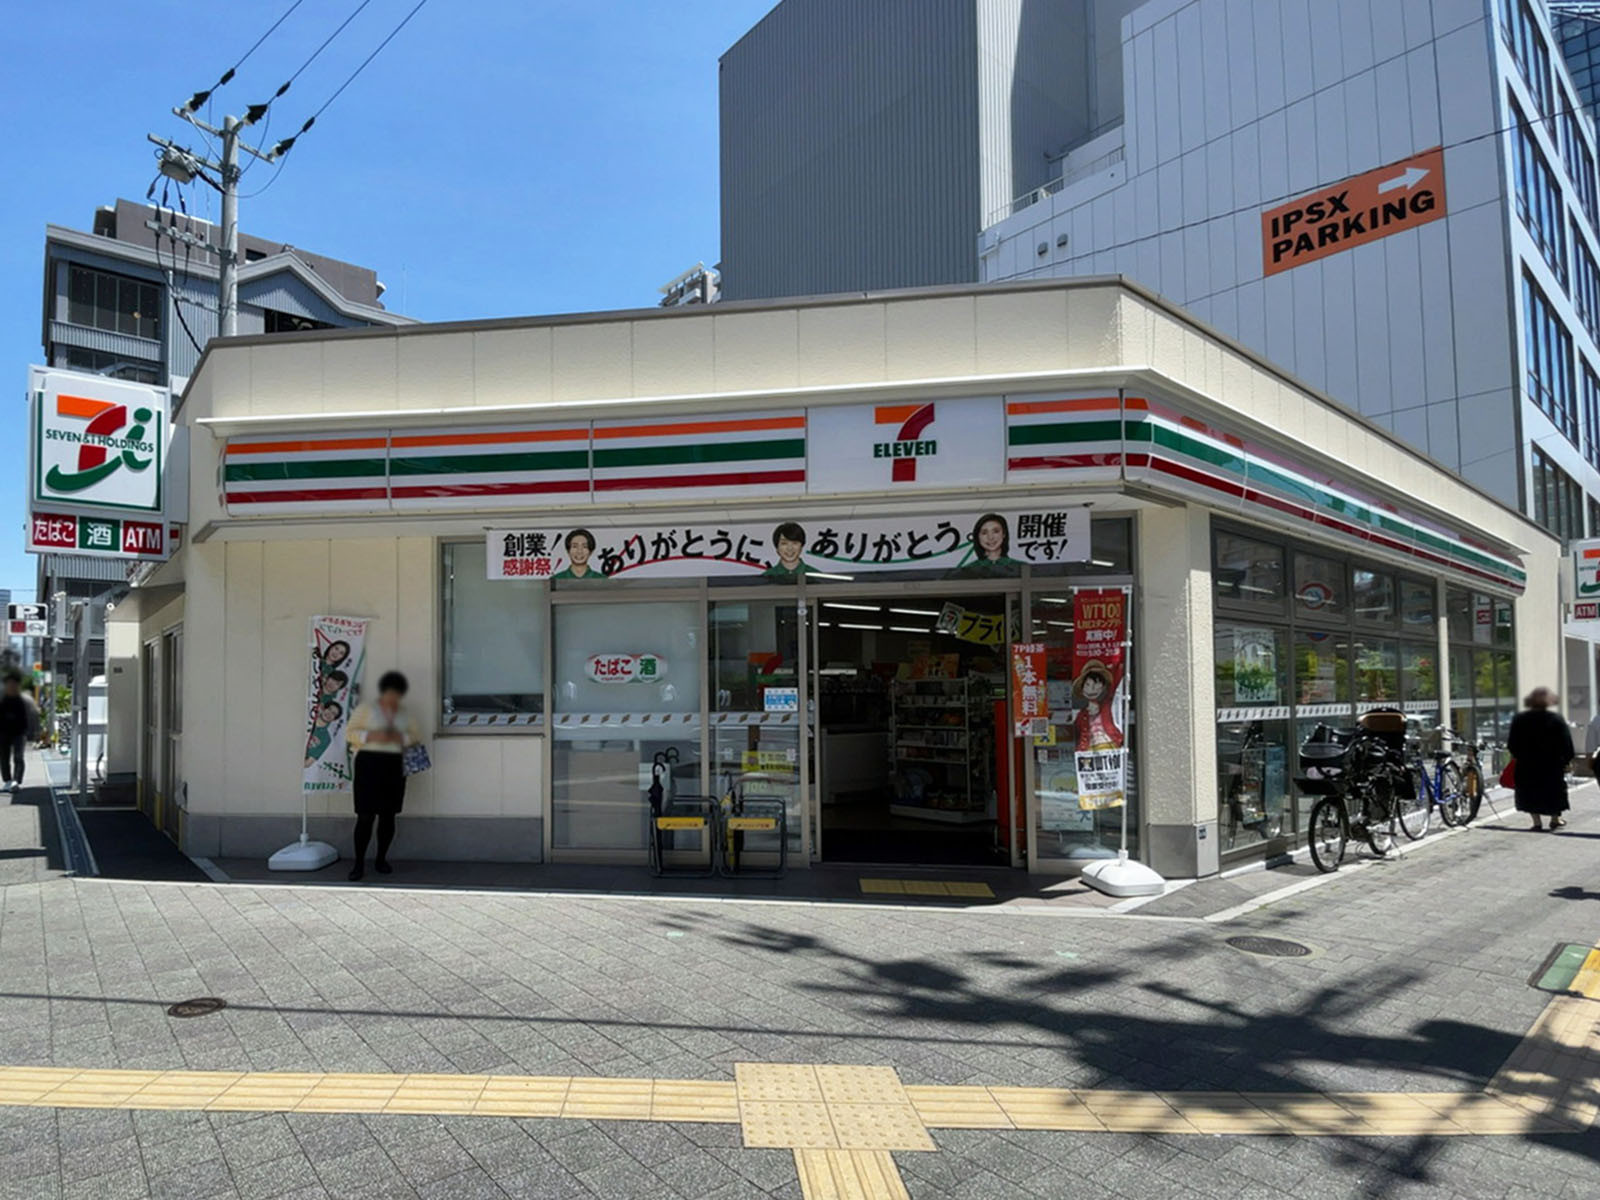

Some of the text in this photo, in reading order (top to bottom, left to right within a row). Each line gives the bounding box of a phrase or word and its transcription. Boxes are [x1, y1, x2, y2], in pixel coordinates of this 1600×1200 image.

[1271, 190, 1350, 239] IPSX
[1272, 190, 1436, 264] PARKING
[97, 435, 155, 454] HOLDINGS
[34, 518, 162, 550] たばこ 酒 ATM
[1016, 512, 1067, 540] 開催
[1017, 539, 1068, 562] です!
[502, 558, 562, 577] 感謝祭!
[16, 604, 40, 620] P
[1576, 604, 1596, 618] ATM
[594, 658, 657, 676] たばこ 酒
